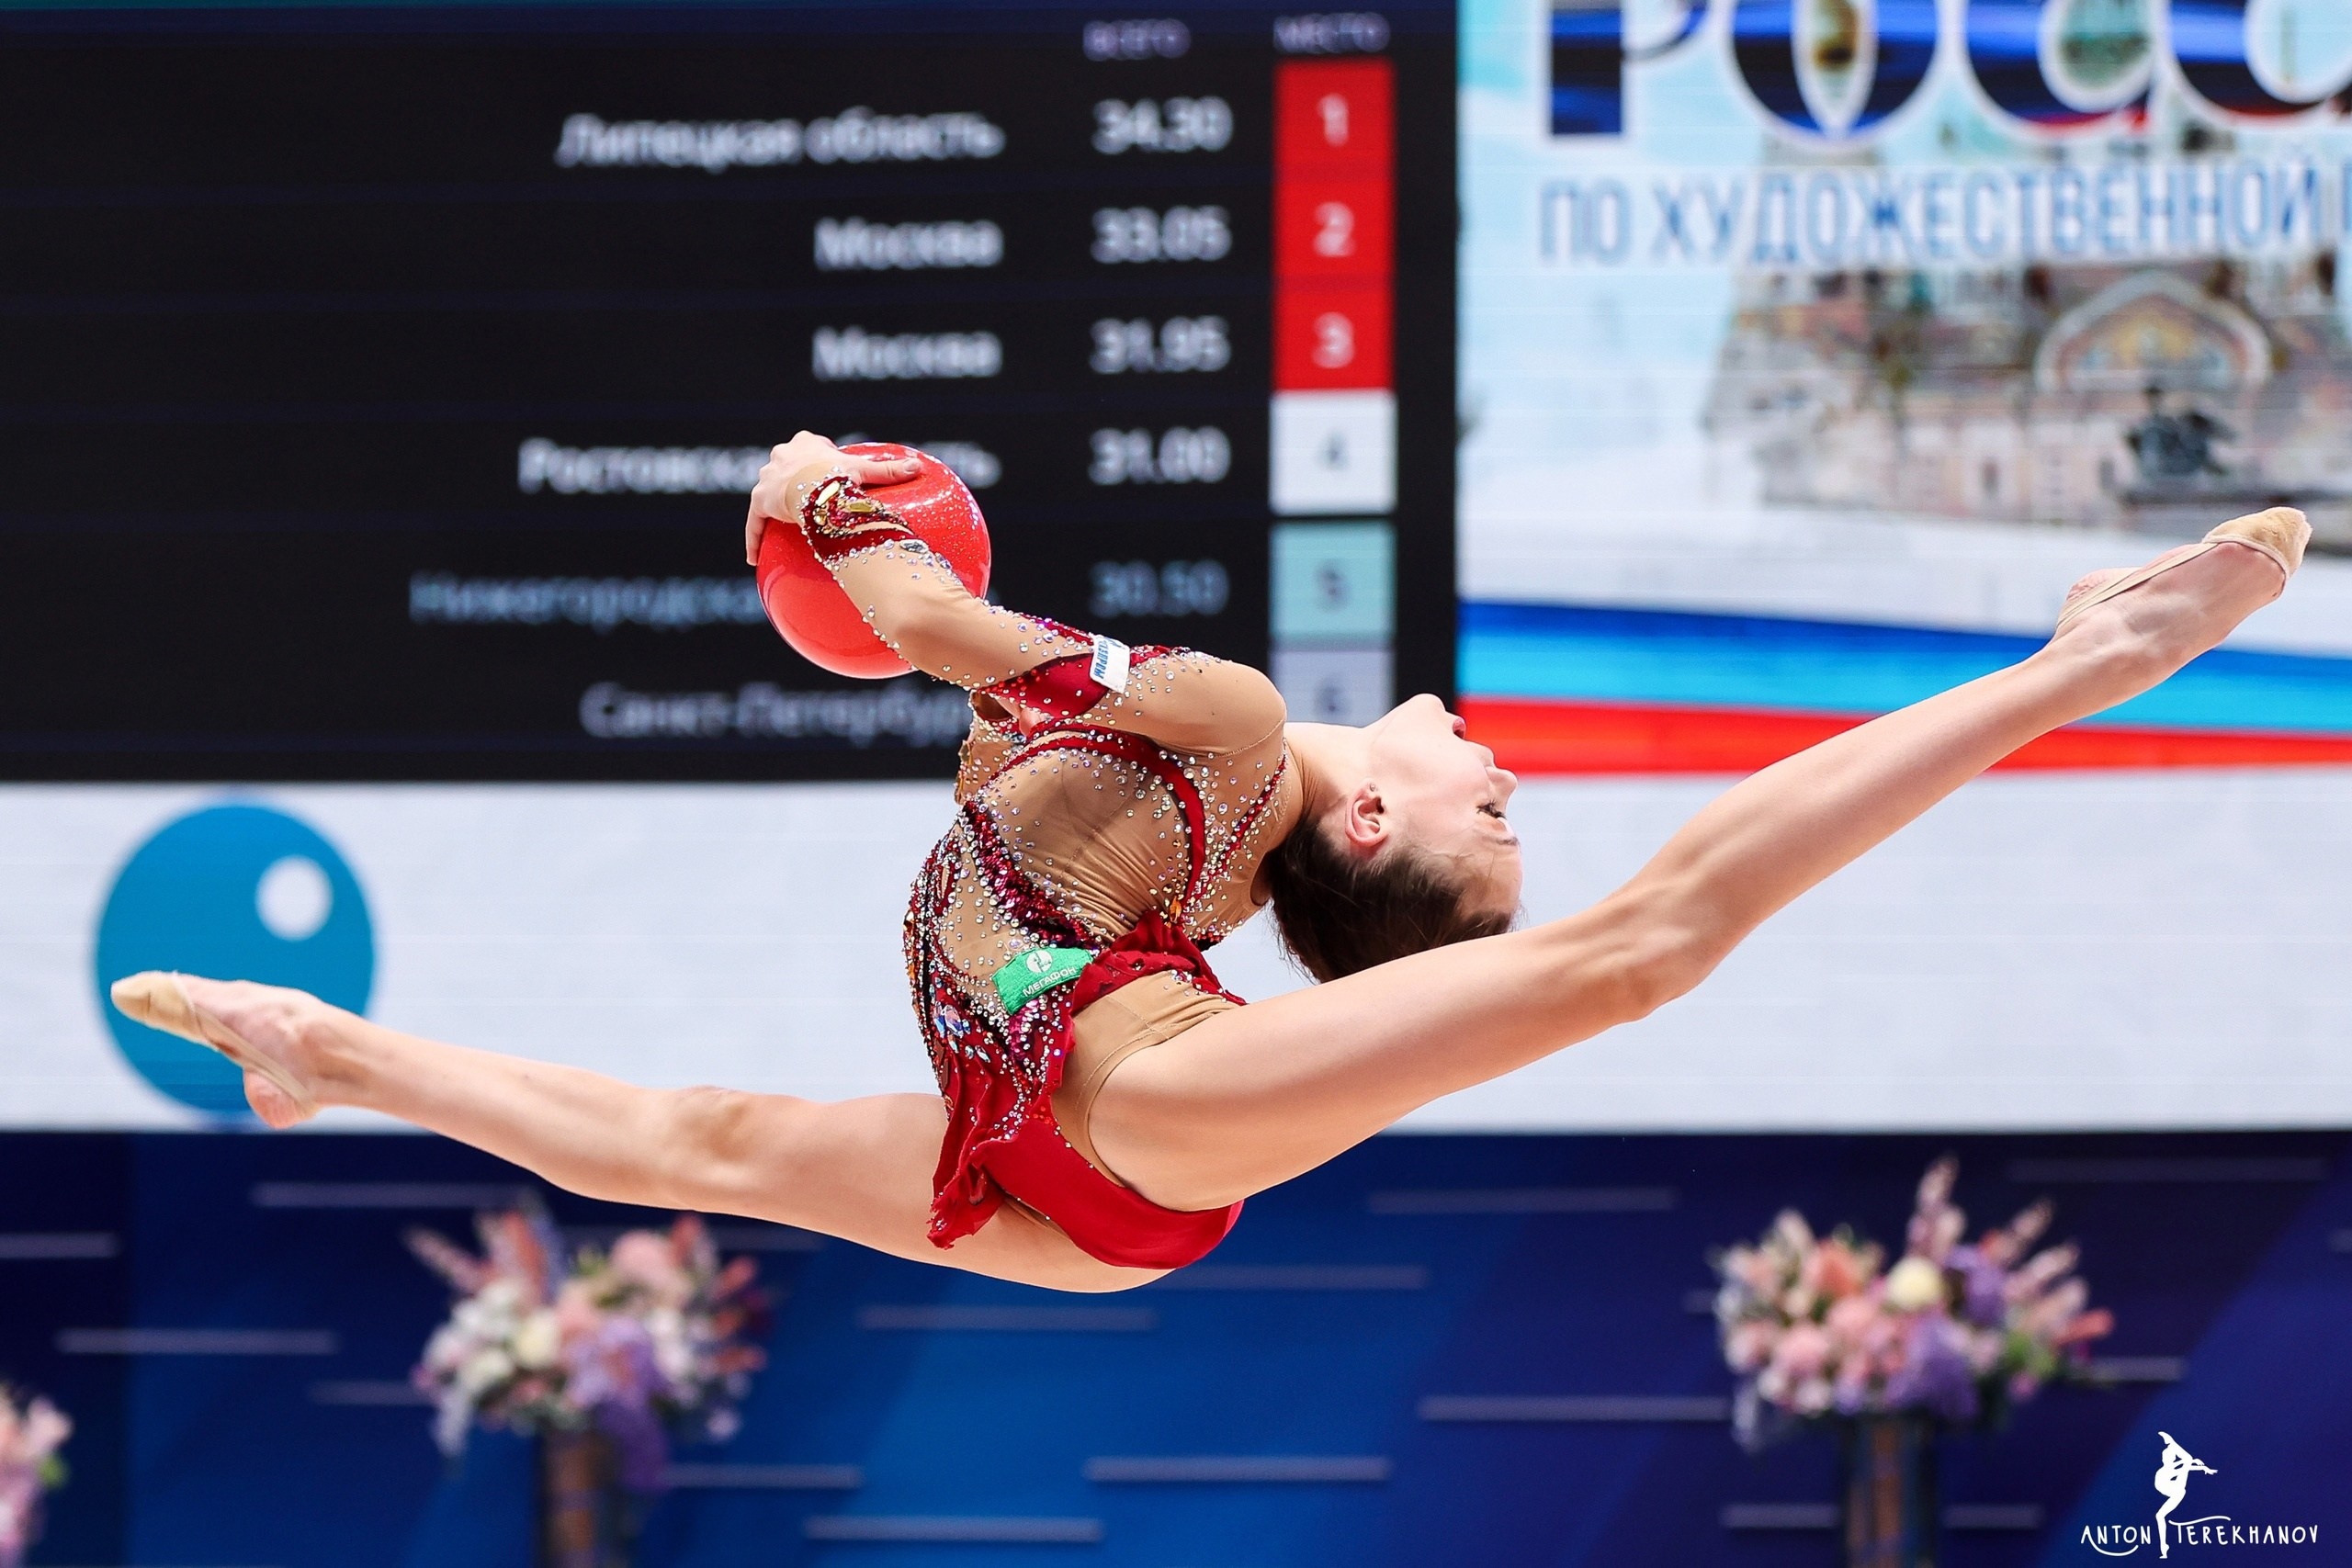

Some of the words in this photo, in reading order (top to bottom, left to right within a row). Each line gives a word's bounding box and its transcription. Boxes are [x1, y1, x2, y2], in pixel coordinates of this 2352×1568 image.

[1274, 14, 1389, 53] МЕСТО
[557, 112, 802, 174] Липецкая
[806, 105, 1005, 162] область
[1093, 97, 1232, 153] 34.30
[1317, 93, 1350, 146] 1
[1092, 207, 1231, 263] 33.05
[1314, 202, 1354, 257] 2
[1540, 176, 1634, 265] ПО
[1651, 152, 2321, 268] ХУДОЖЕСТВЕННОЙ
[815, 217, 1003, 270] Москва
[813, 326, 1001, 380] Москва
[1312, 311, 1355, 368] 3
[519, 437, 763, 494] Ростовска
[1023, 966, 1077, 997] МЕГАФОН
